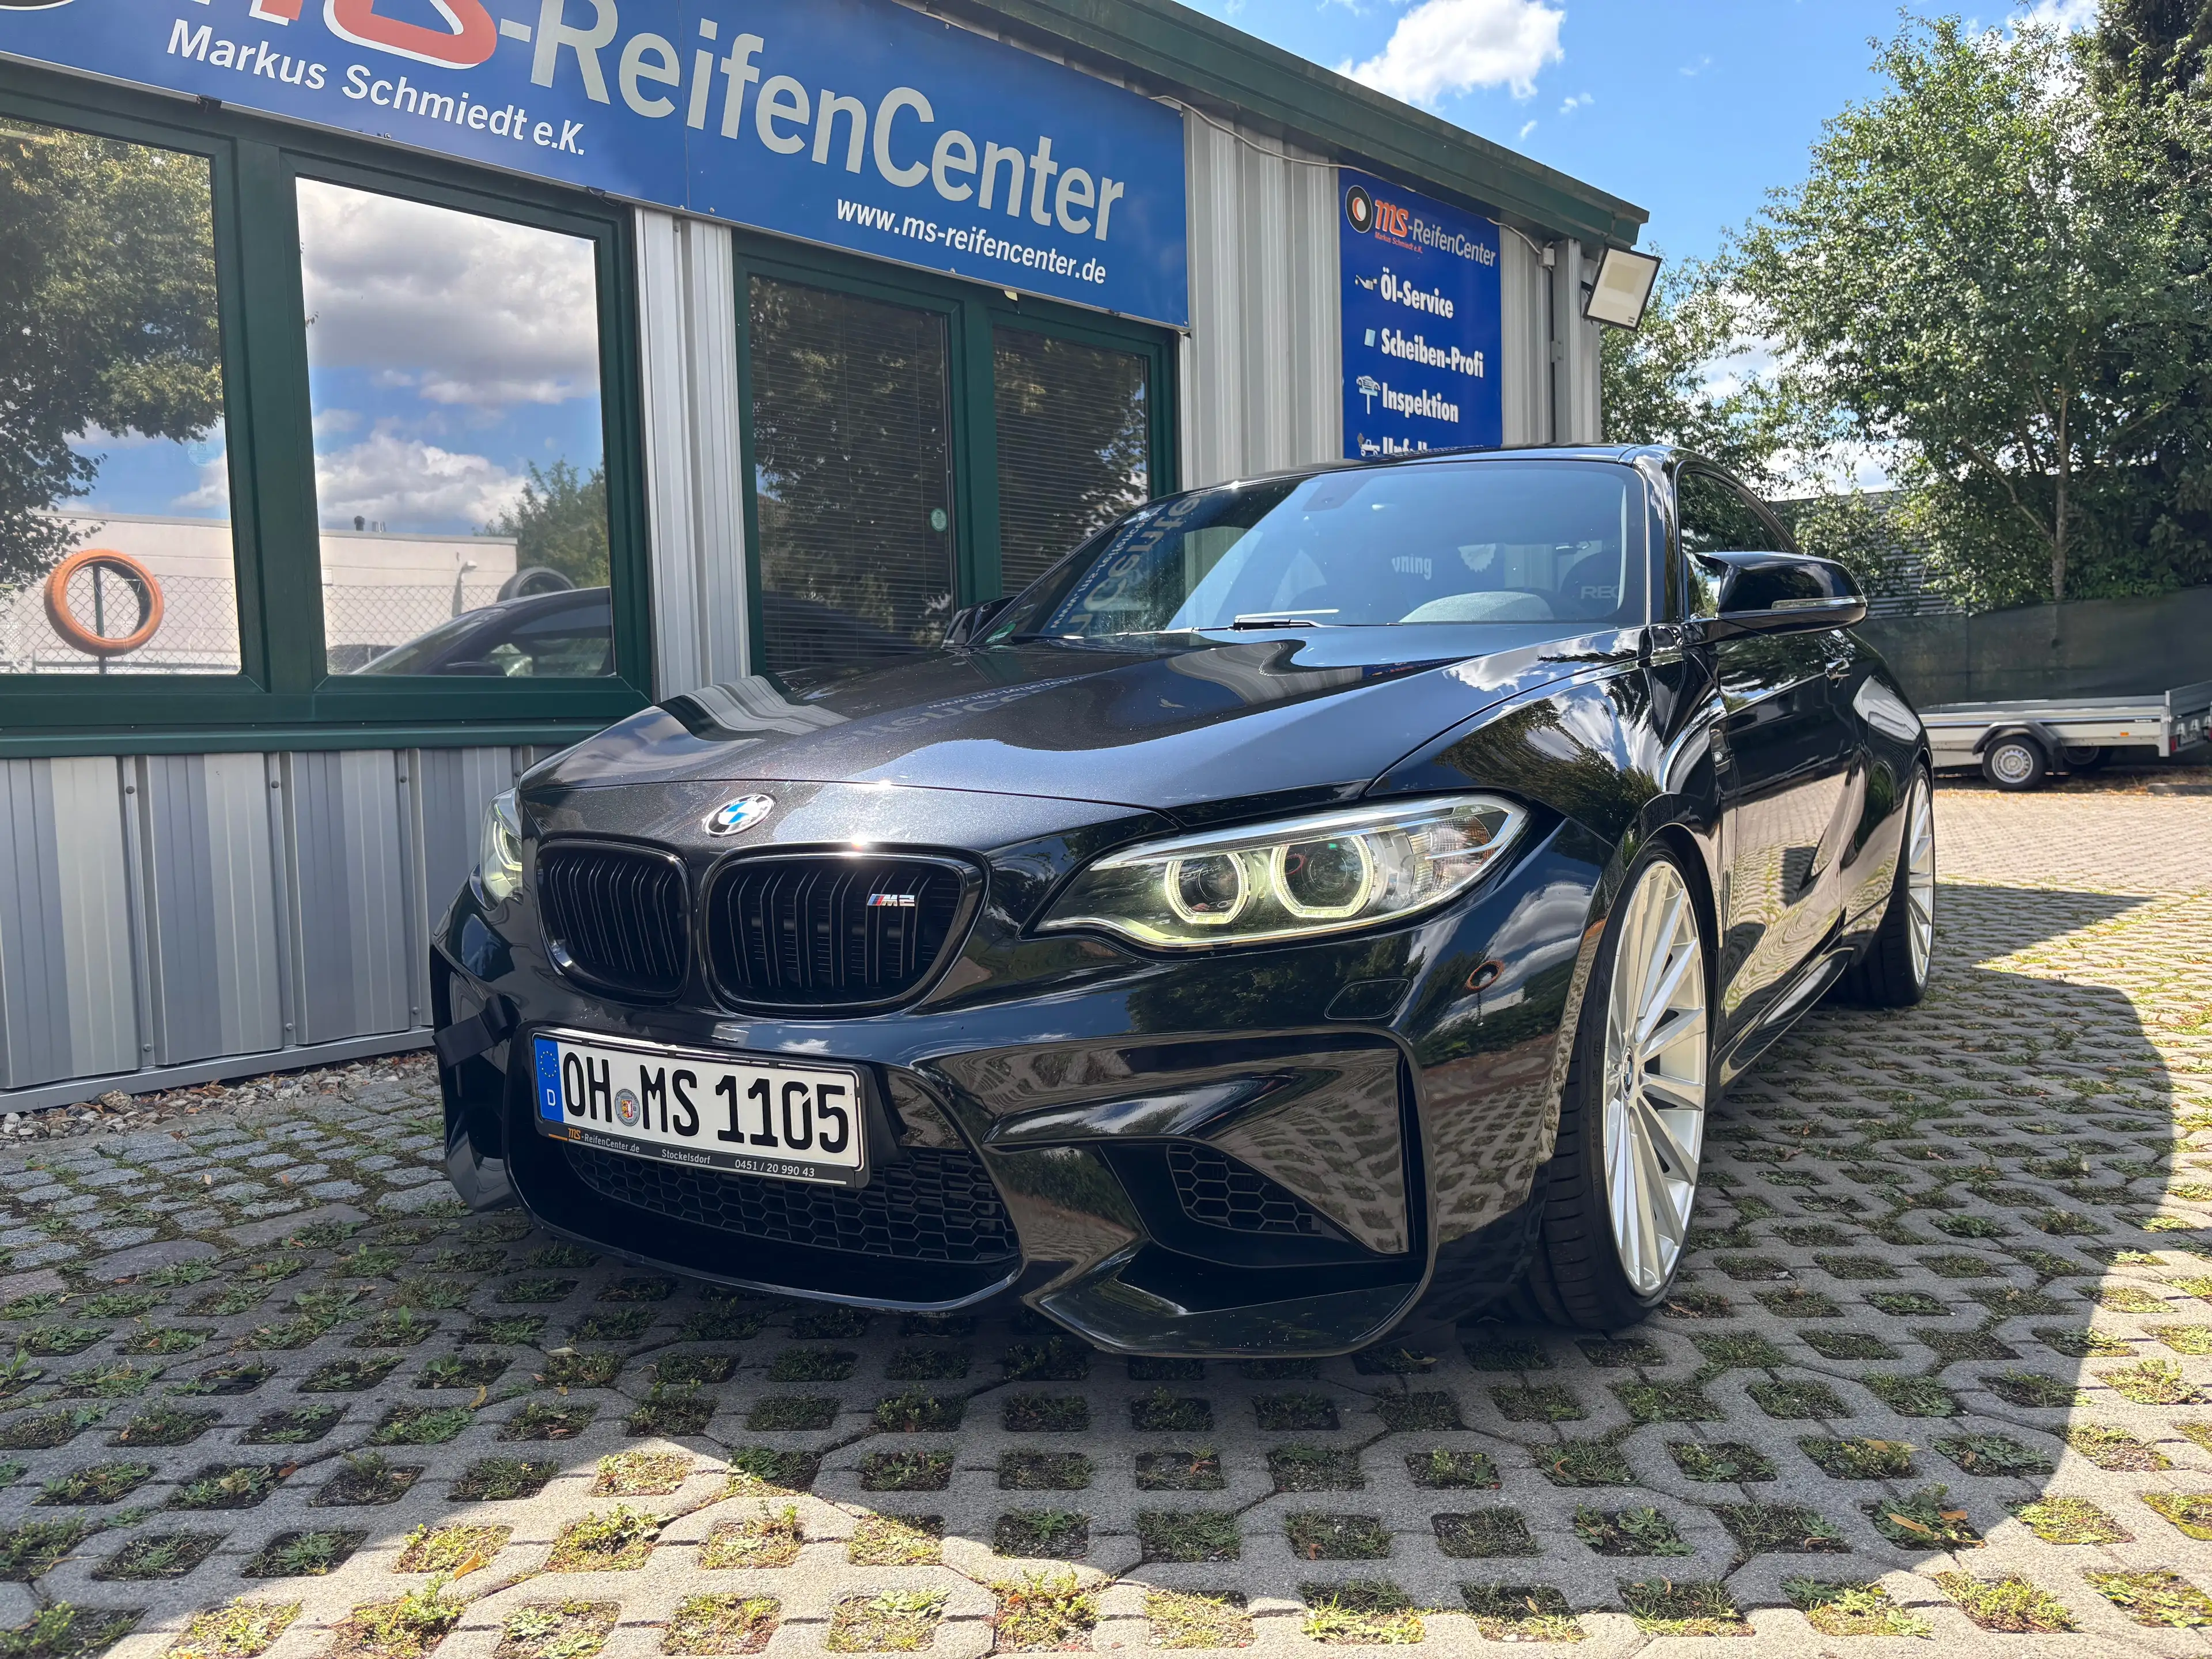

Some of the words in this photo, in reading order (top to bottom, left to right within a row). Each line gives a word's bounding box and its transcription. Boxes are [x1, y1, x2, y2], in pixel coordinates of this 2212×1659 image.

[166, 18, 328, 90] Markus
[342, 64, 527, 141] Schmiedt
[532, 120, 585, 156] e.K.
[177, 0, 1124, 241] -ReifenCenter
[837, 198, 1106, 284] www.ms-reifencenter.de
[1380, 267, 1454, 319] Öl-Service
[1381, 328, 1484, 378] Scheiben-Profi
[1382, 382, 1459, 423] Inspektion
[879, 894, 915, 907] M2
[547, 1088, 556, 1107] D
[562, 1051, 613, 1123] OH
[639, 1064, 700, 1137] MS
[715, 1074, 850, 1154] 1105
[661, 1149, 711, 1165] Stockelsdorf
[734, 1159, 757, 1171] 0451
[767, 1163, 779, 1173] 20
[781, 1165, 800, 1176] 990
[802, 1167, 815, 1177] 43
